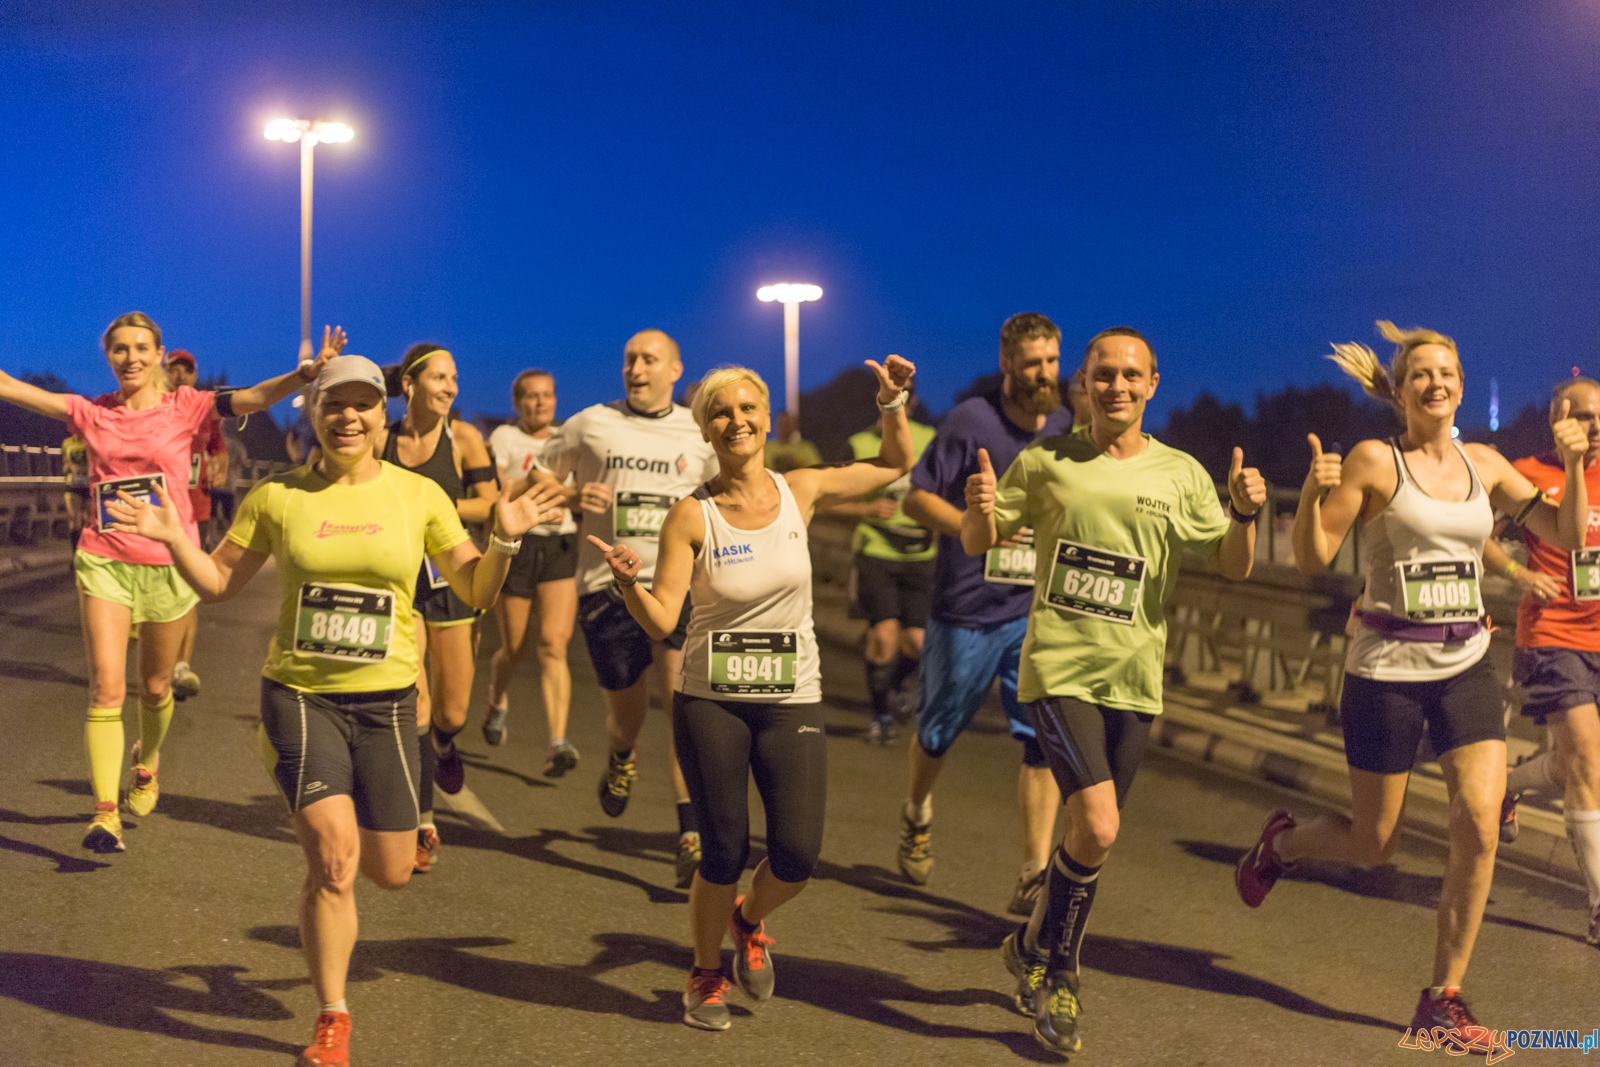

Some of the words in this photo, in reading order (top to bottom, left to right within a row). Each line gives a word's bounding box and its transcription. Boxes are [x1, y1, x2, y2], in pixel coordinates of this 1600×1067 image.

[606, 449, 669, 474] incom
[1137, 495, 1171, 513] WOJTEK
[713, 544, 752, 559] KASIK
[1063, 569, 1126, 606] 6203
[1419, 582, 1471, 608] 4009
[310, 612, 377, 646] 8849
[727, 656, 783, 681] 9941
